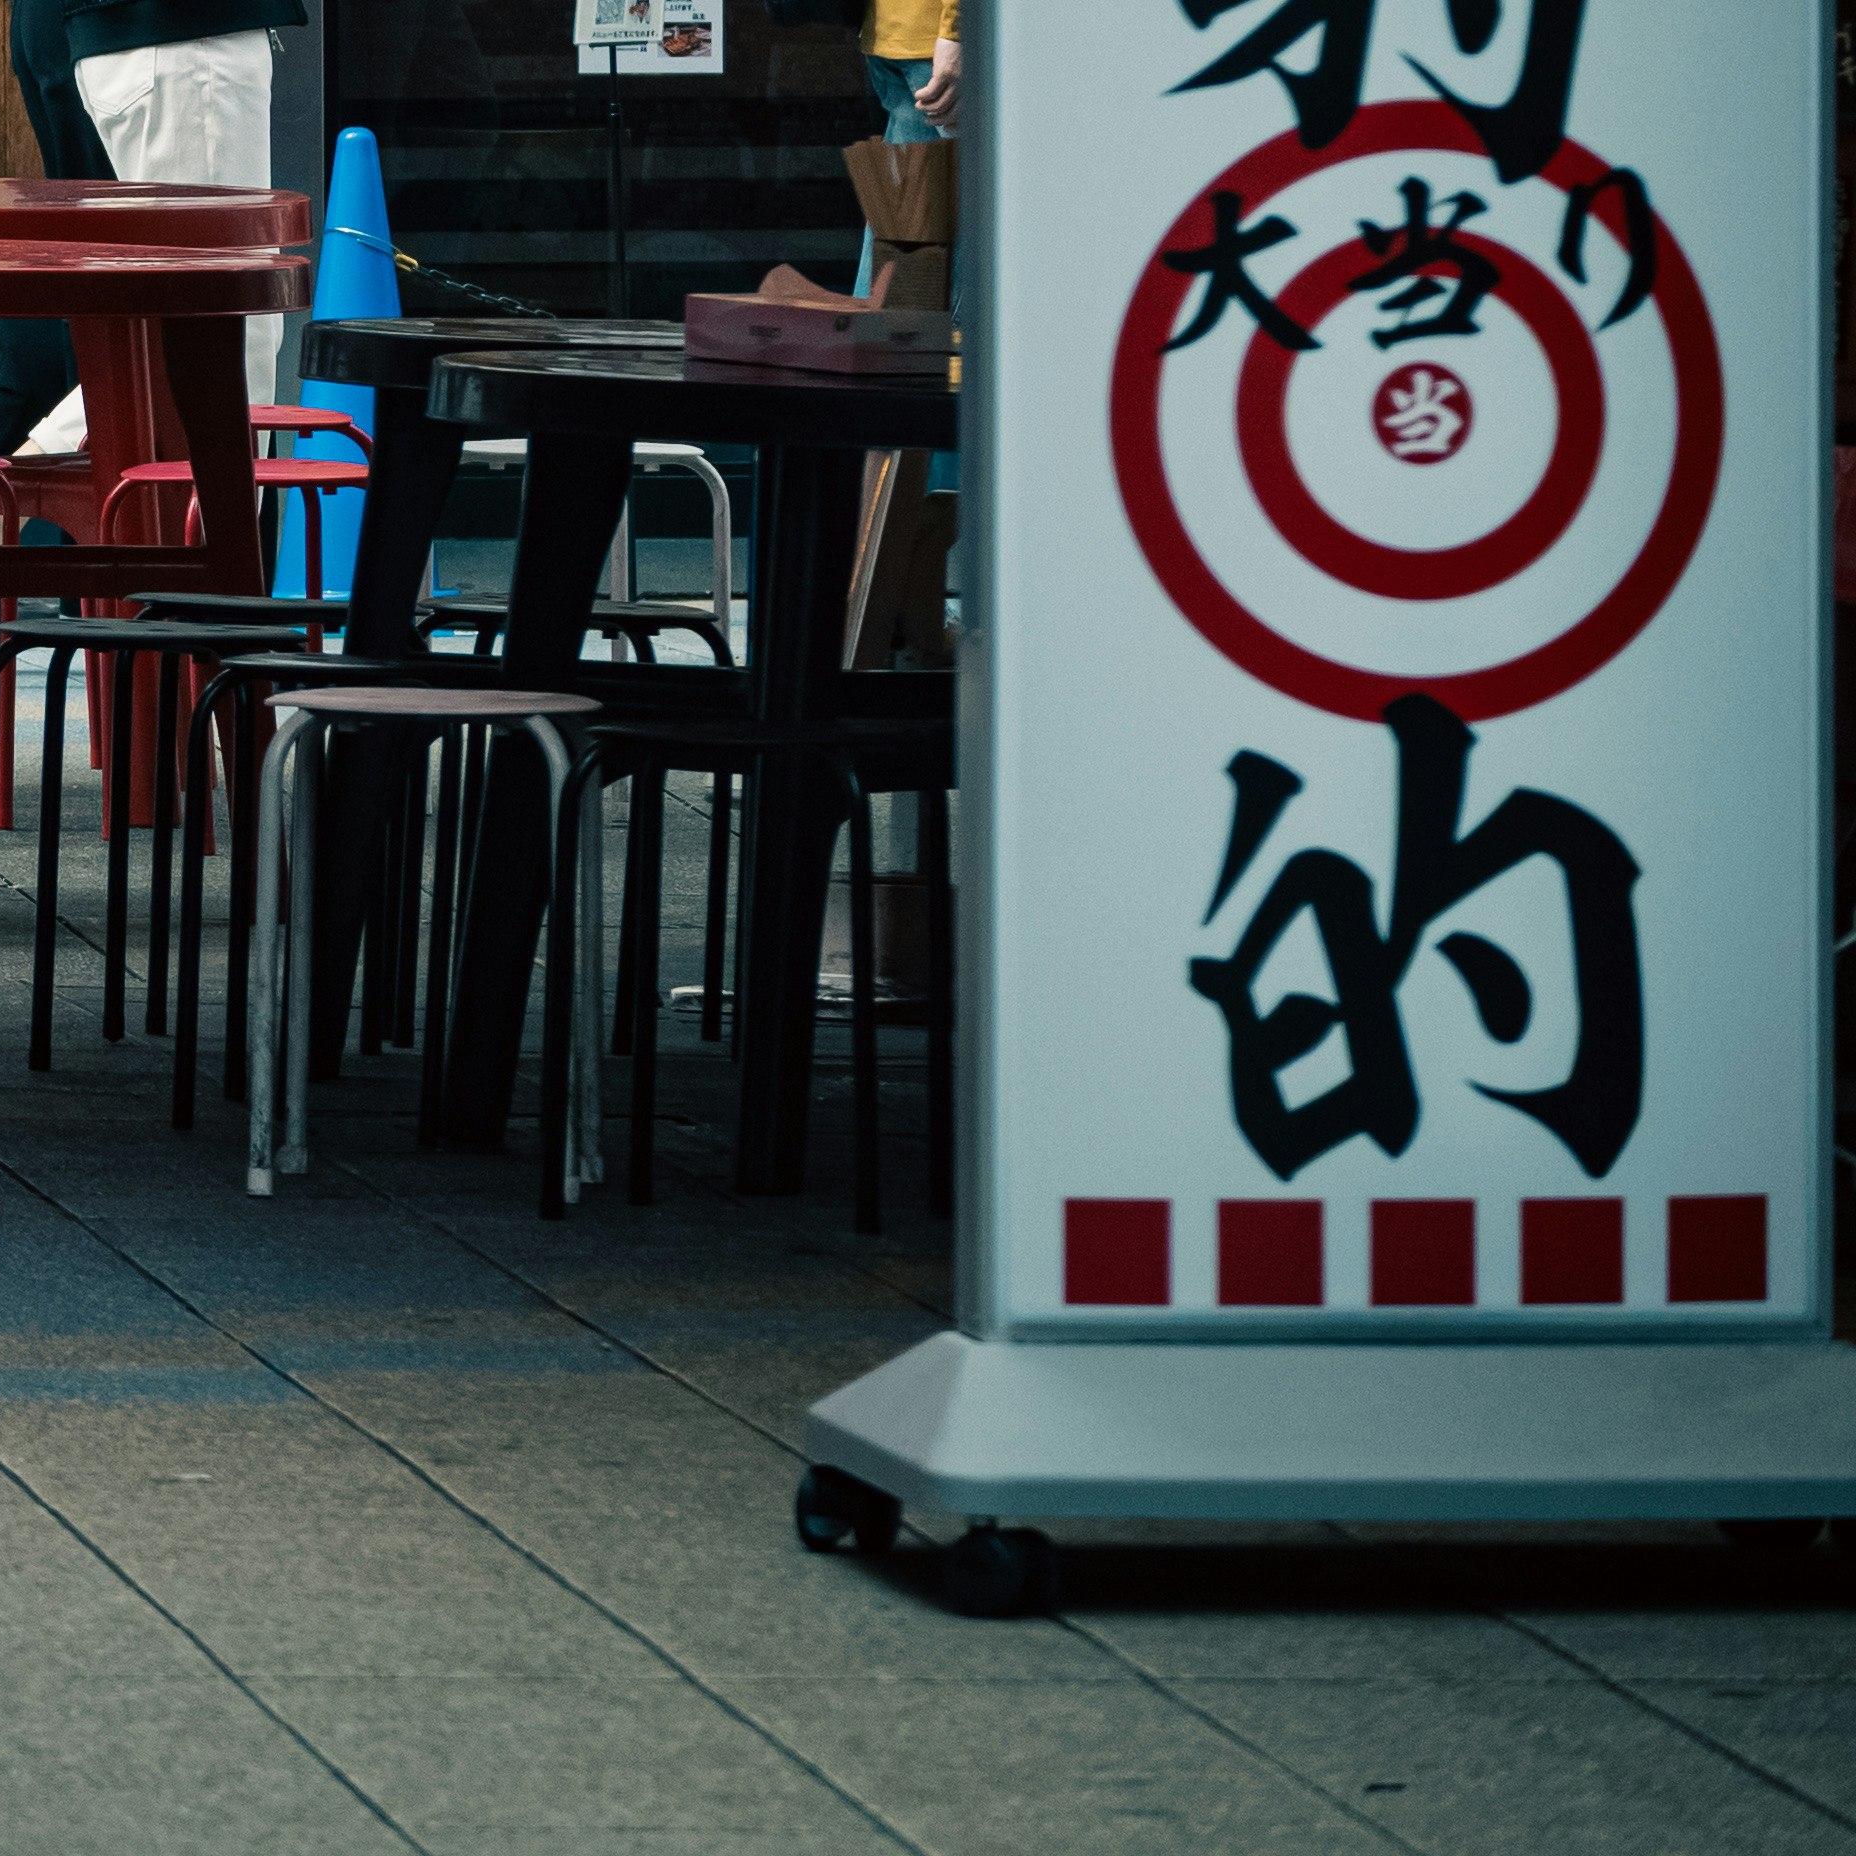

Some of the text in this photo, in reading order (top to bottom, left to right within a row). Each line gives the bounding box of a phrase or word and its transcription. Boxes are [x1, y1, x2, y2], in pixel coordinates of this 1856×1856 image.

[1159, 166, 1658, 356] 大当り
[1383, 369, 1462, 453] 当
